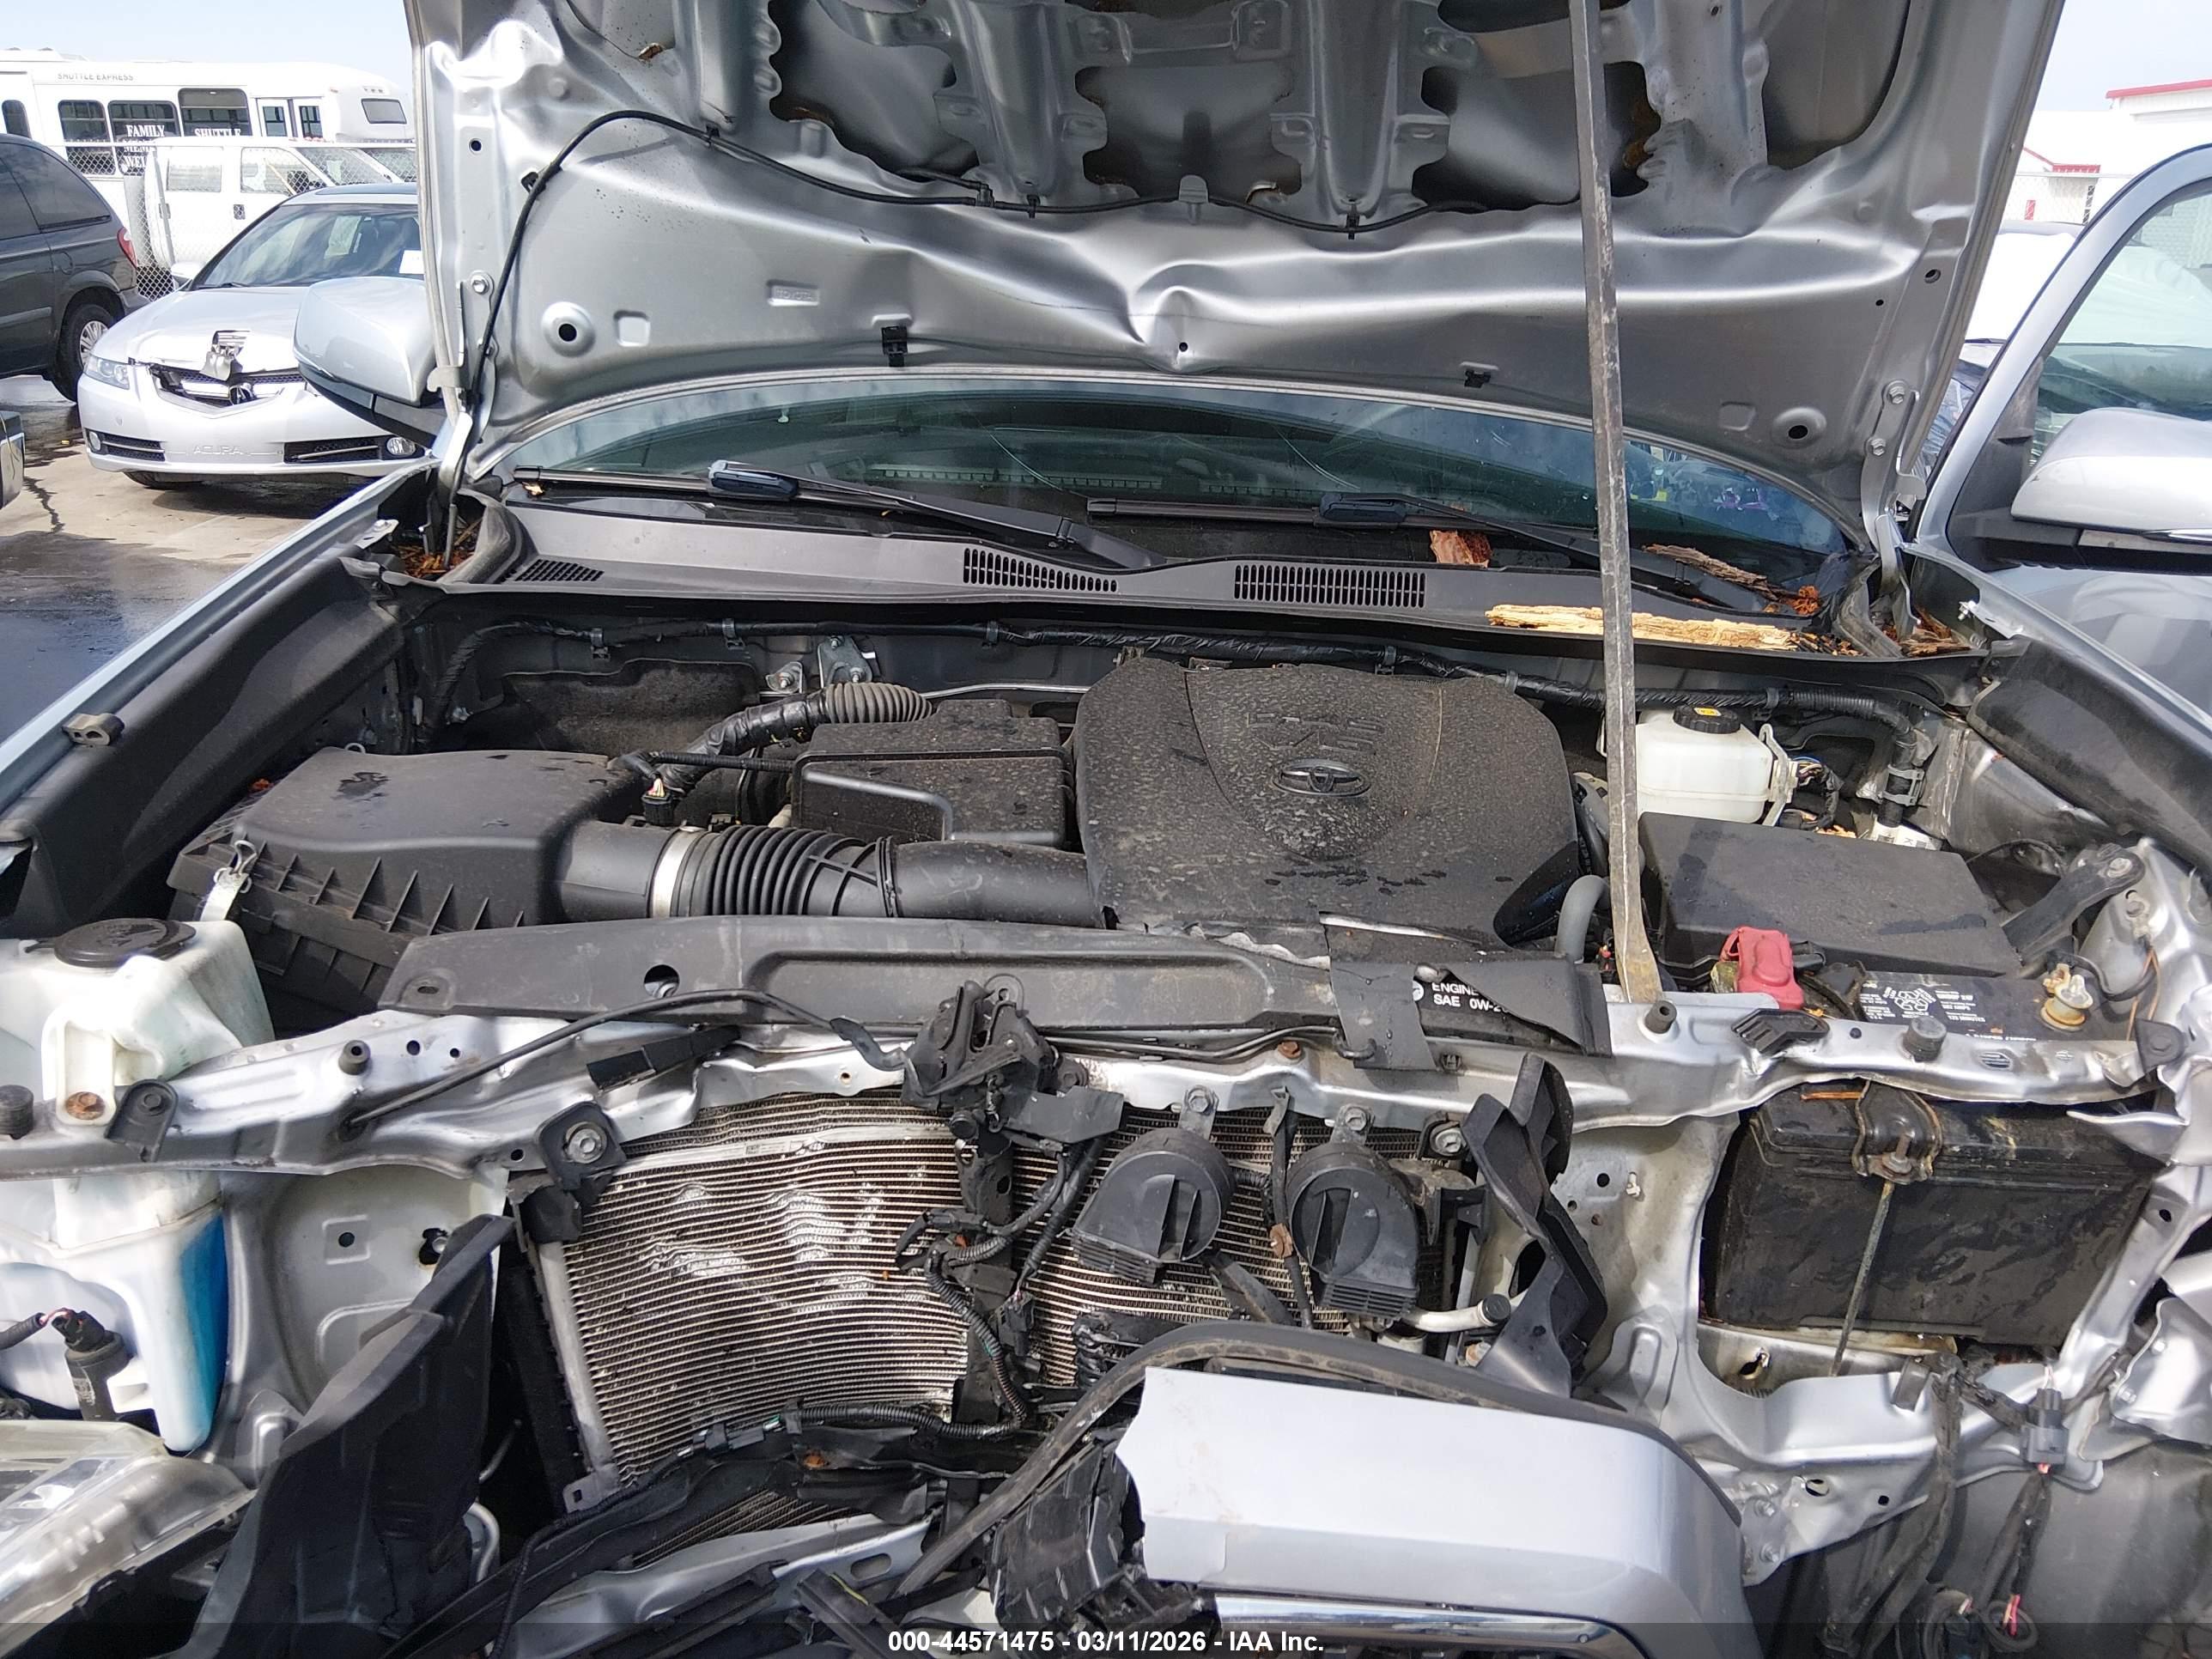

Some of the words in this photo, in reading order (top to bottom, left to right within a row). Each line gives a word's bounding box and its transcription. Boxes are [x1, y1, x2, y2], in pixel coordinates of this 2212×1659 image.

[126, 125, 165, 137] FAMILY
[193, 445, 244, 455] ACURA
[1433, 993, 1462, 1007] SAE
